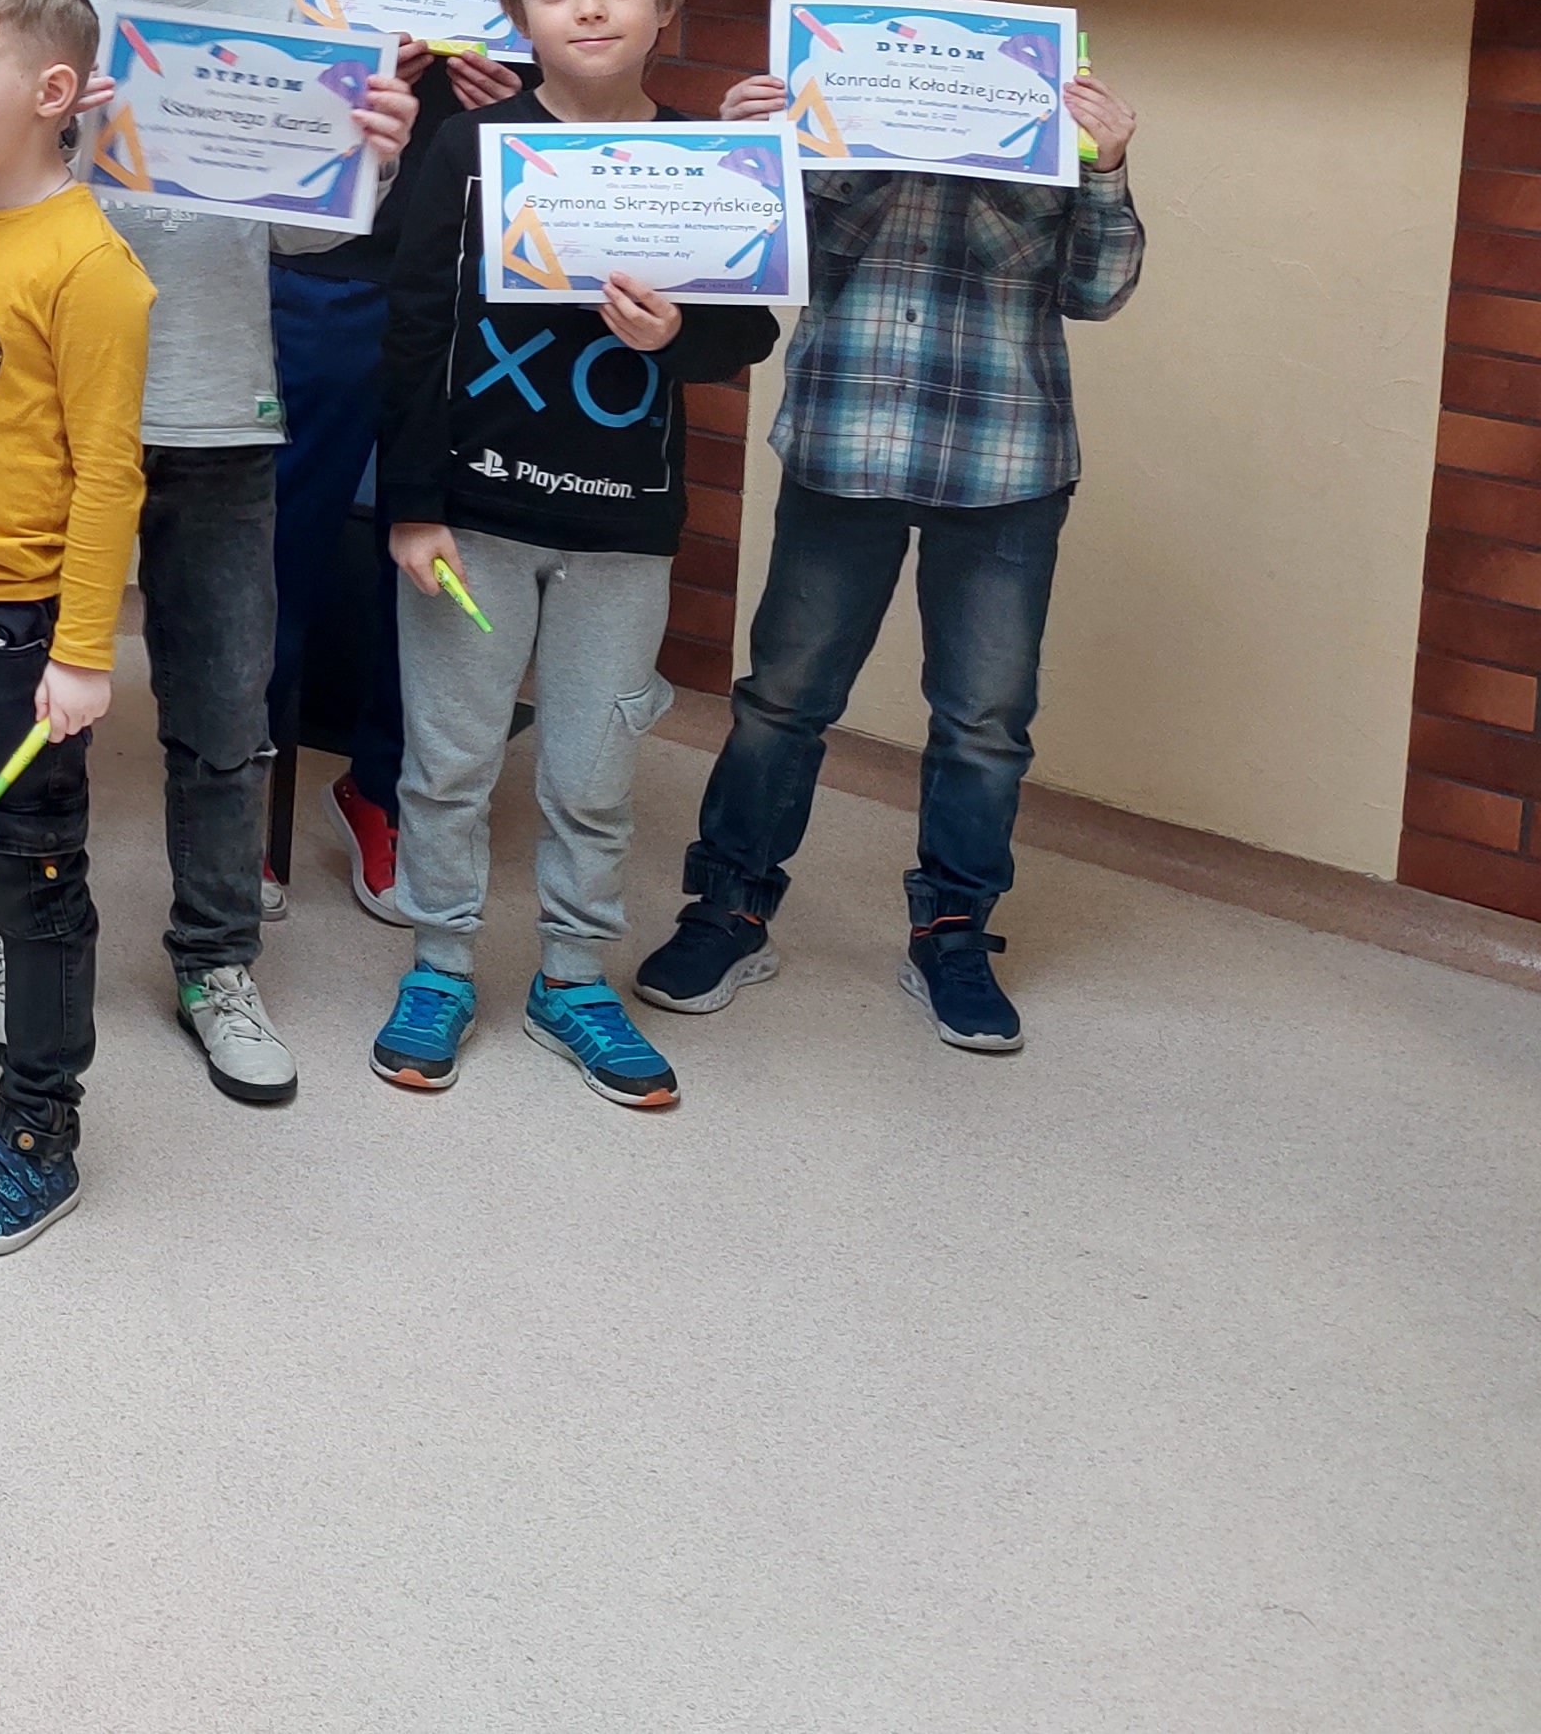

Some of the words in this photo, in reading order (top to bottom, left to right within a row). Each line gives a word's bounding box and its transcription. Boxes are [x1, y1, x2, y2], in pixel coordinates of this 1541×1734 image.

[876, 41, 985, 60] DYPLOM
[194, 66, 305, 92] DYPLOM
[825, 72, 901, 89] Konrada
[908, 76, 1050, 105] Kołodziejczyka
[591, 166, 705, 177] DYPLOM
[524, 195, 607, 212] Szymona
[613, 196, 784, 216] Skrzypczyńskiego
[516, 460, 632, 499] PlayStation
